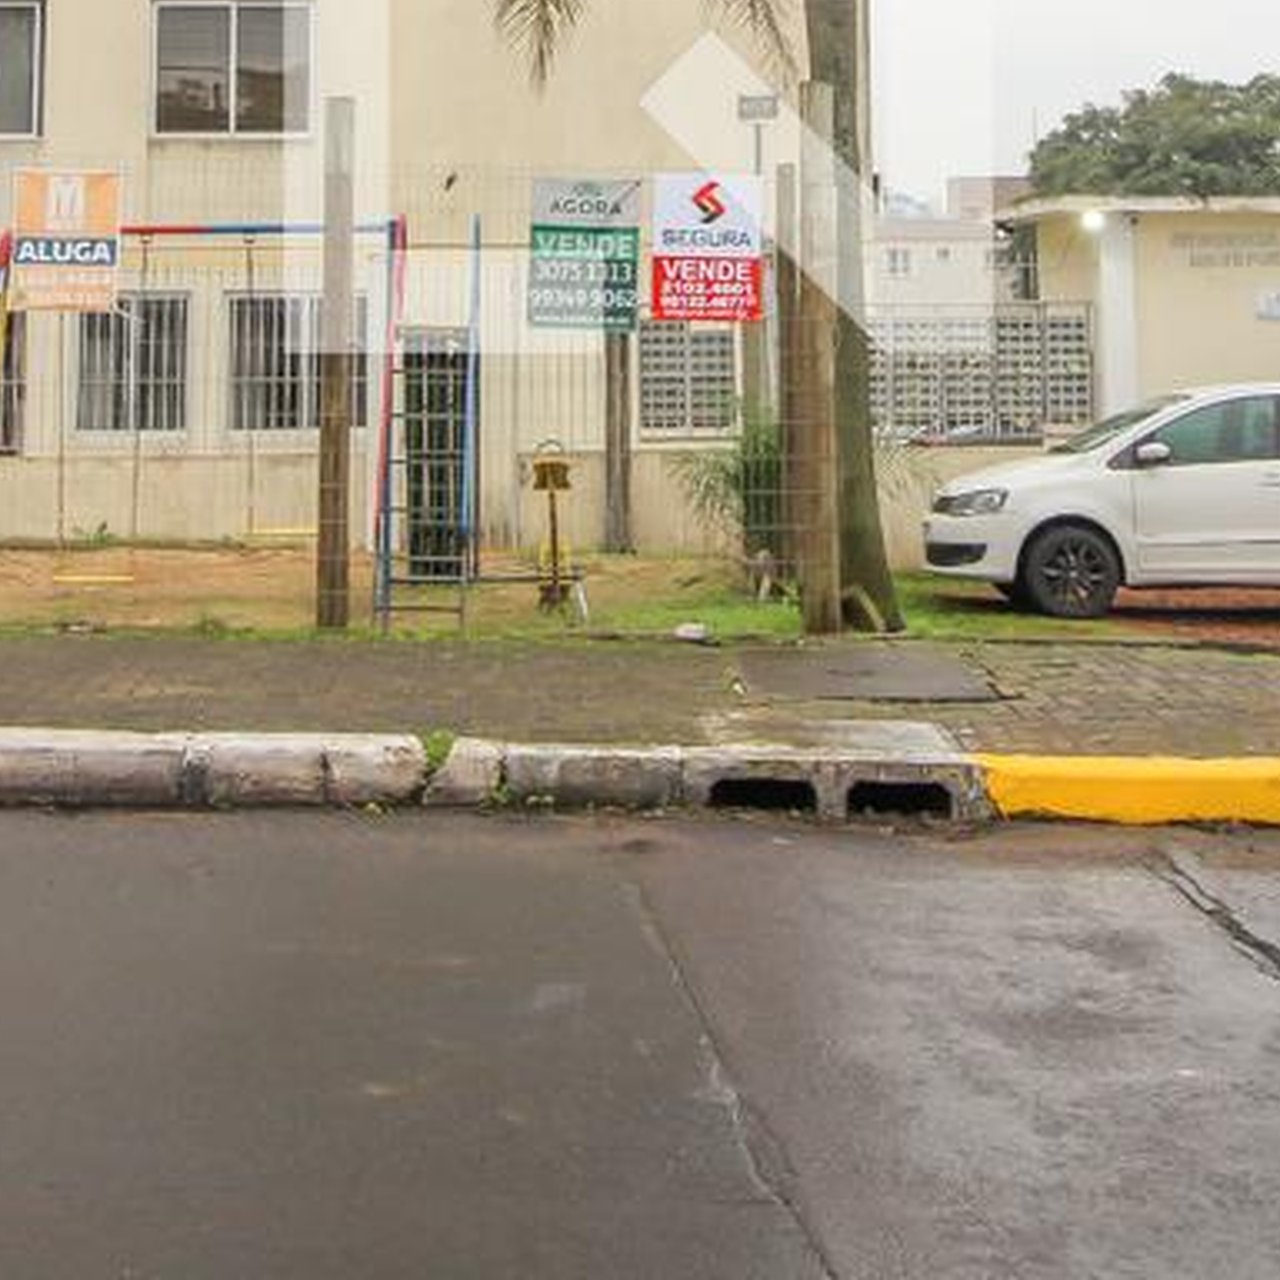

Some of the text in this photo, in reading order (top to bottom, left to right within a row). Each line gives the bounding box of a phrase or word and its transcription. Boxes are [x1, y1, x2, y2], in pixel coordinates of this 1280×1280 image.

[535, 233, 635, 258] VENDE
[662, 229, 751, 247] SEGURA
[17, 240, 111, 262] ALUGA
[662, 260, 752, 280] VENDE
